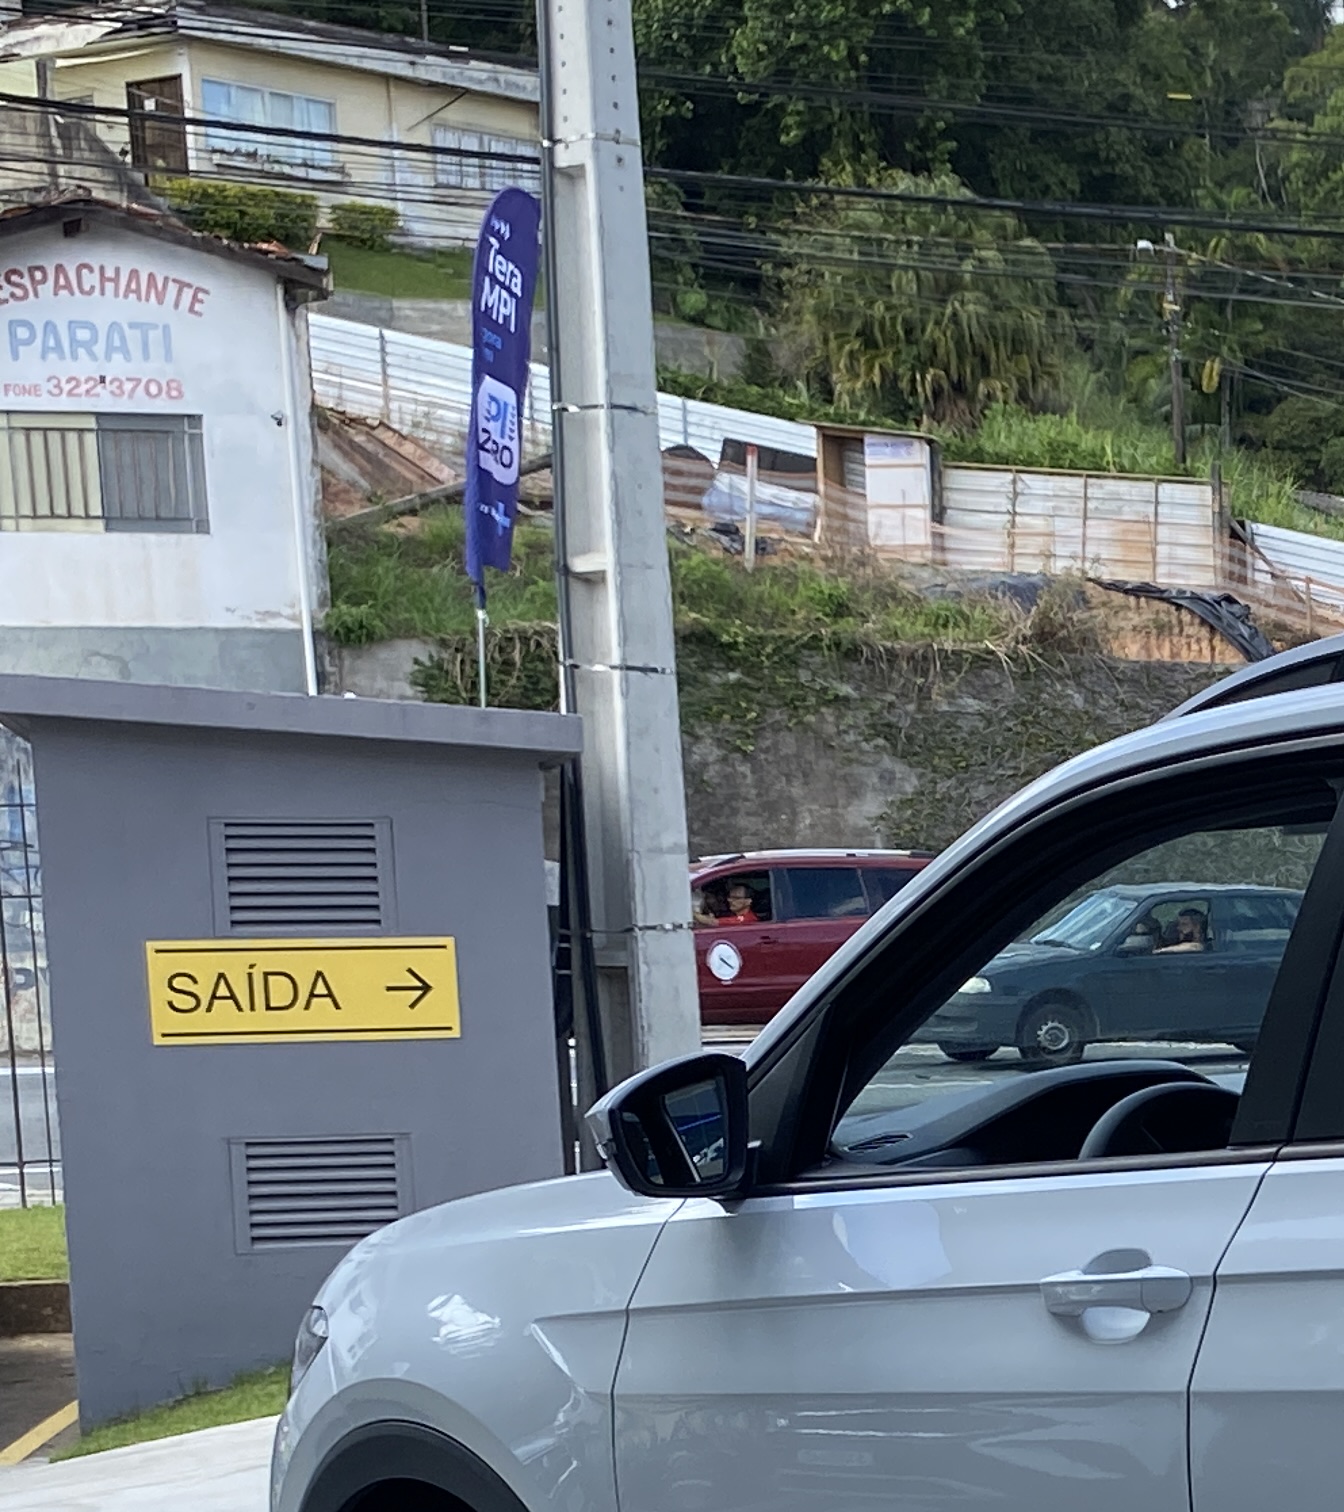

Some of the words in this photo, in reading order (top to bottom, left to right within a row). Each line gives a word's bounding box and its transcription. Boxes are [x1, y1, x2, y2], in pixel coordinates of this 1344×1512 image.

[487, 235, 523, 298] Tera
[480, 275, 517, 334] MPI
[8, 318, 174, 364] PARATI
[3, 382, 43, 398] FONE
[166, 962, 342, 1014] SAÍDA
